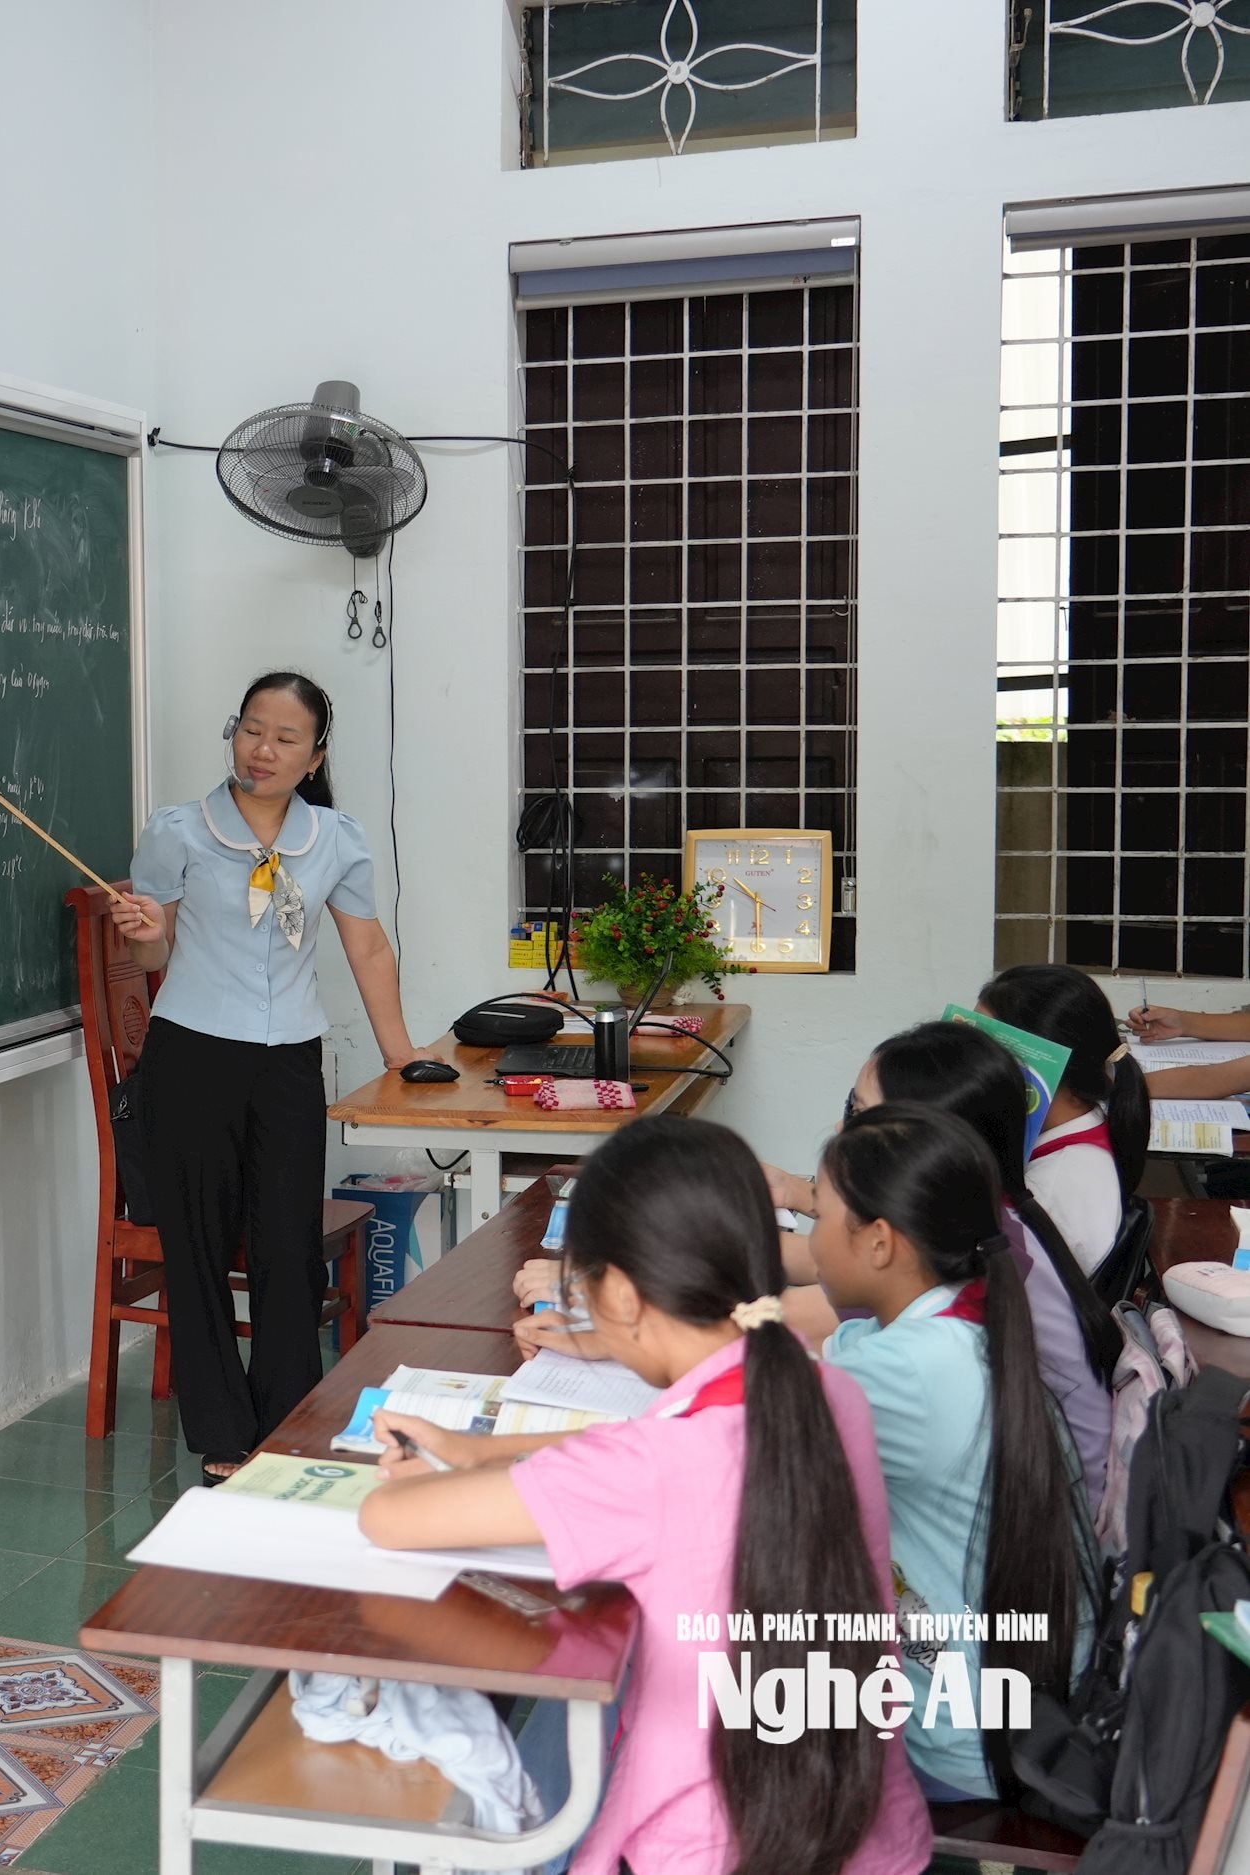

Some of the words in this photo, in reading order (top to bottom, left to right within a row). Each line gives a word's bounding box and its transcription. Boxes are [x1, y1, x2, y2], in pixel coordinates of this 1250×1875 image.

[728, 849, 740, 865] 11
[750, 849, 769, 865] 12
[786, 849, 791, 865] 1
[705, 867, 726, 883] 10
[798, 867, 812, 884] 2
[797, 894, 813, 910] 3
[796, 920, 810, 936] 4
[778, 938, 794, 953] 5
